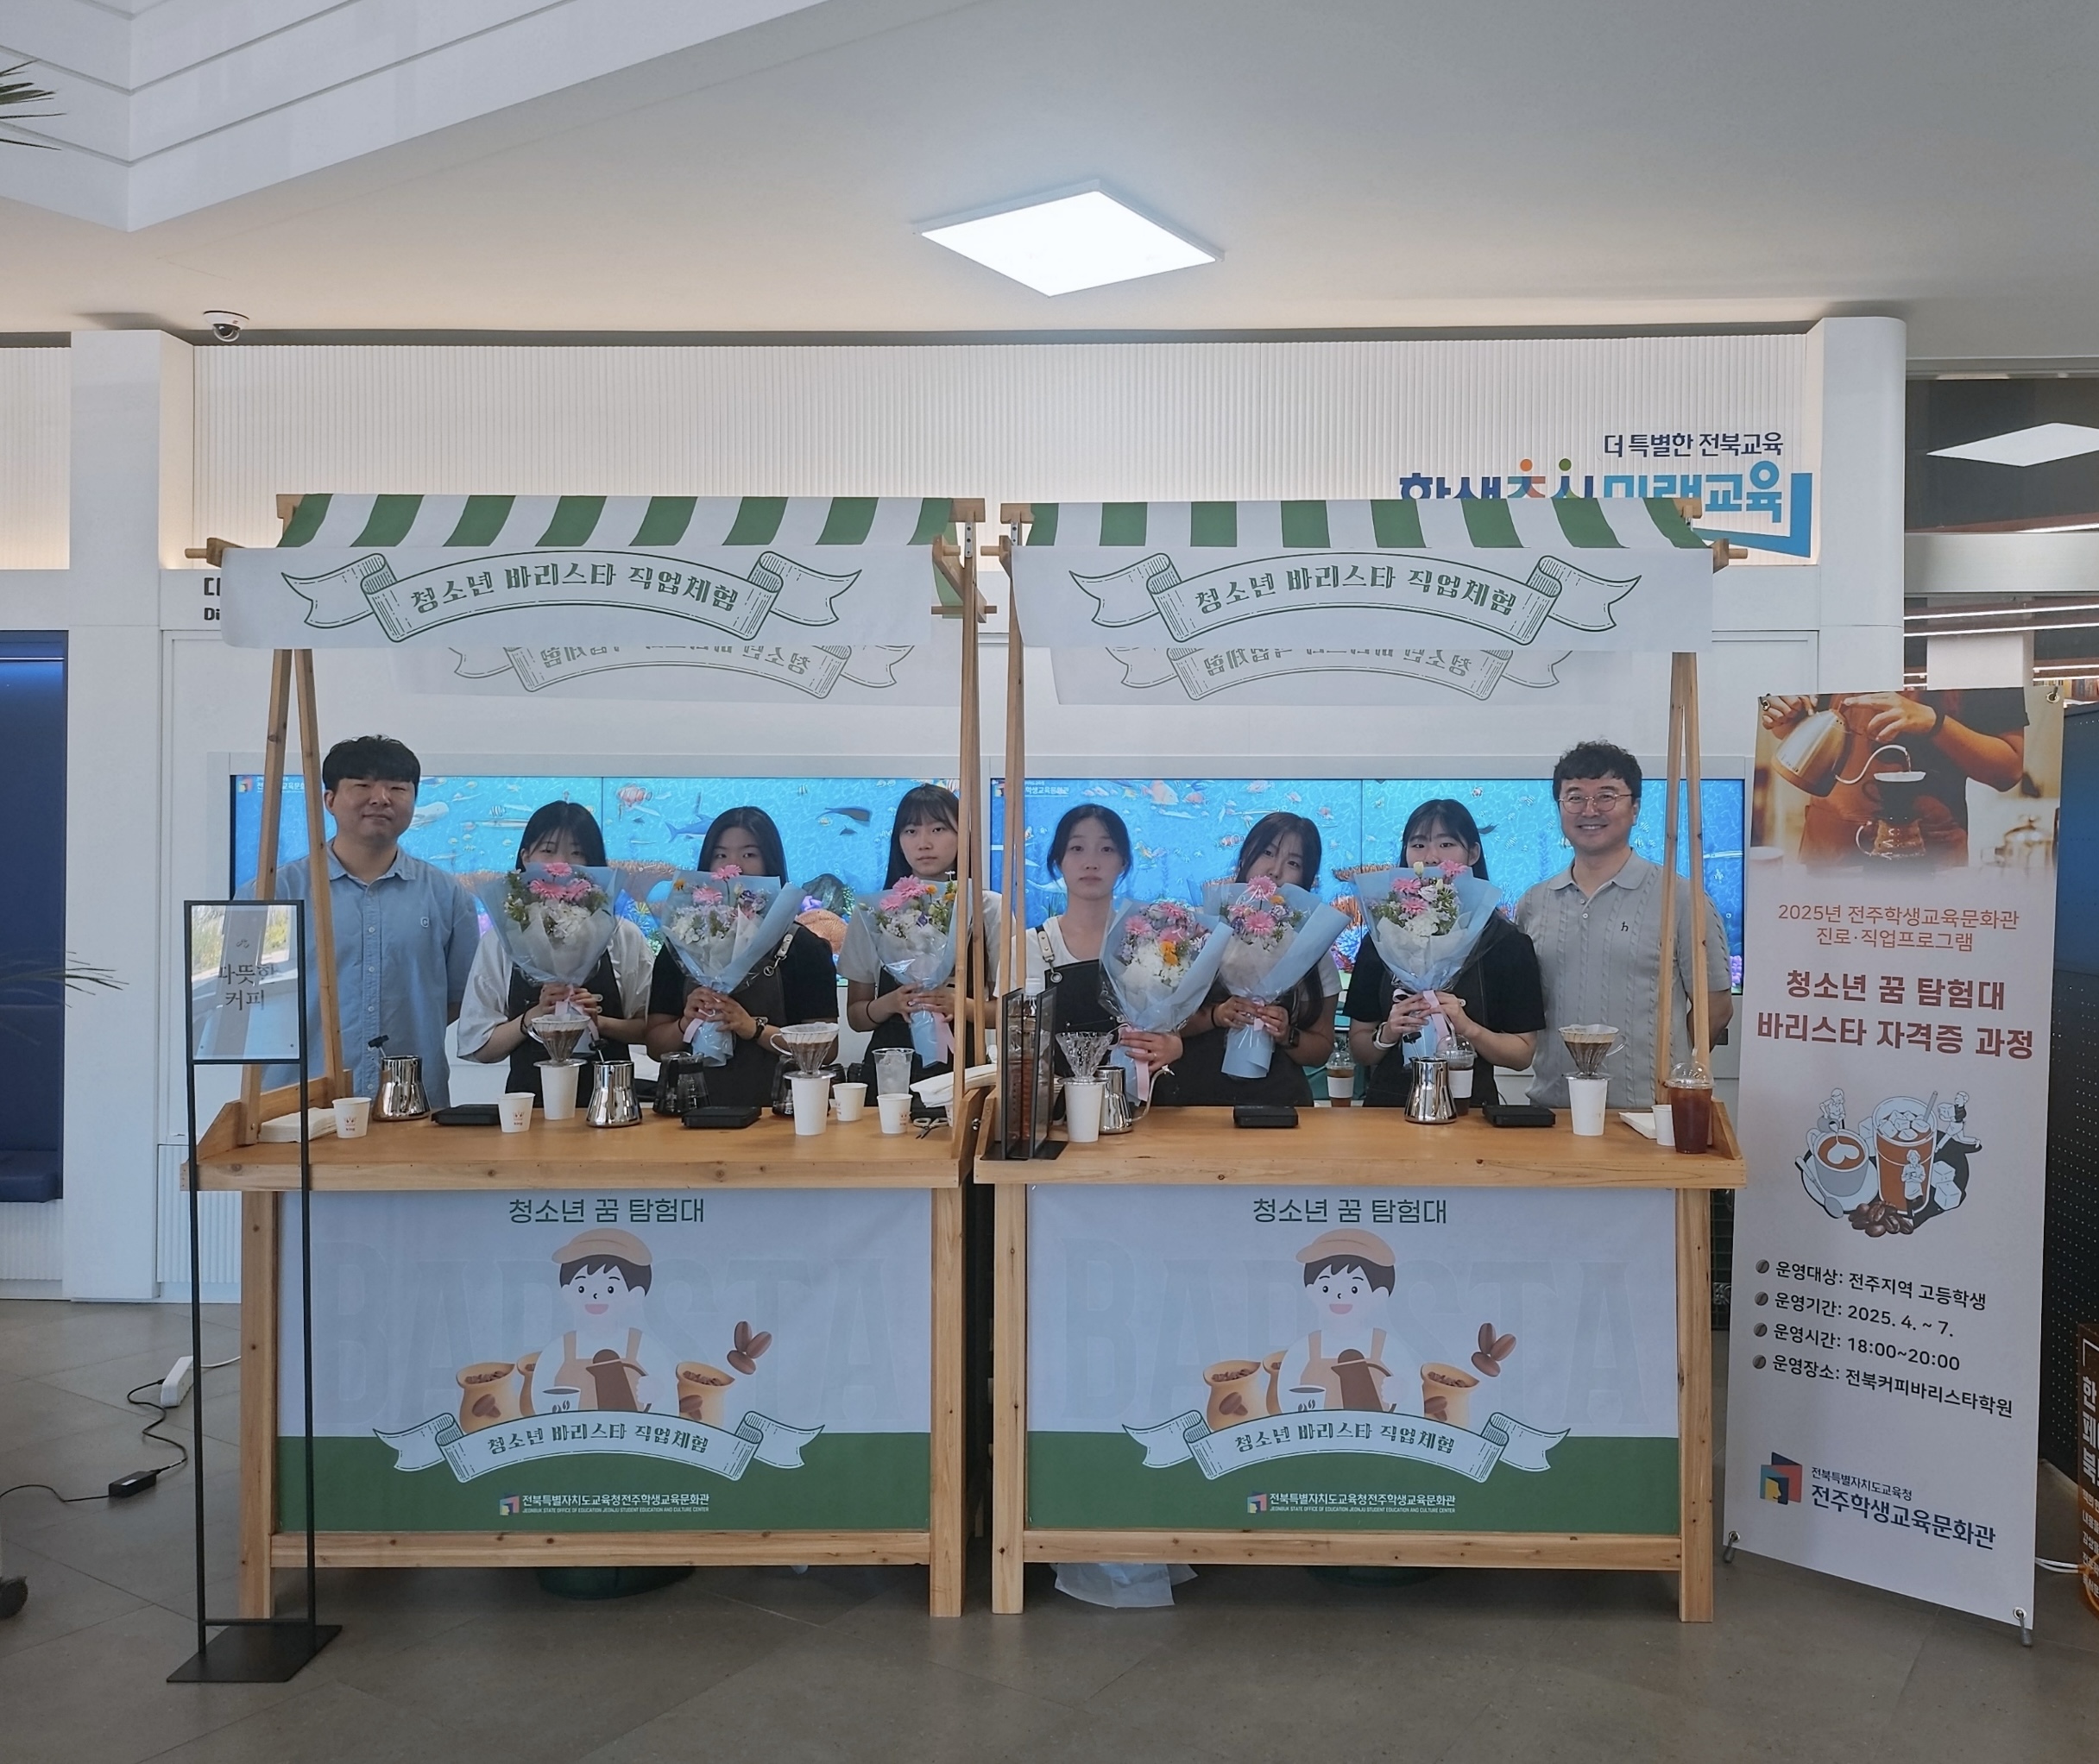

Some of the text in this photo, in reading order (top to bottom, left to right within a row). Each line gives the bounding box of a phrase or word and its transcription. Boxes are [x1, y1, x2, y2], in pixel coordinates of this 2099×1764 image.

[1604, 432, 1784, 458] 더 특별한 전북교육
[411, 565, 739, 614] 청소년 바리스타 직업체험
[1194, 565, 1516, 615] 청소년 바리스타 직업체험
[1777, 904, 2020, 930] 2025년 전주학생교육문화관
[224, 989, 265, 1011] 커피
[1786, 969, 2006, 1011] 청소년 꿈 탐험대
[1756, 1011, 2034, 1060] 바리스타 자격증 과정
[508, 1197, 705, 1224] 청소년 꿈 탐험대
[1252, 1197, 1447, 1225] 청소년 꿈 탐험대
[1774, 1260, 1987, 1312] 운영대상: 전주지역 고등학생
[1774, 1291, 1843, 1318] 운영기간:
[1847, 1304, 1897, 1327] 2025.
[1900, 1314, 1918, 1332] 4.
[1937, 1320, 1955, 1339] 7.
[1773, 1323, 1961, 1371] 운영시간: 18:00~20:00
[1772, 1354, 2014, 1419] 운영장소: 전북커피바리스타학원
[487, 1423, 709, 1454] 청소년 바리스타 직업체험
[1234, 1421, 1455, 1455] 청소년 바리스타 직업체험
[1811, 1465, 1913, 1503] 전북특별자치도교육청
[1810, 1483, 1997, 1551] 전주학생교육문화관
